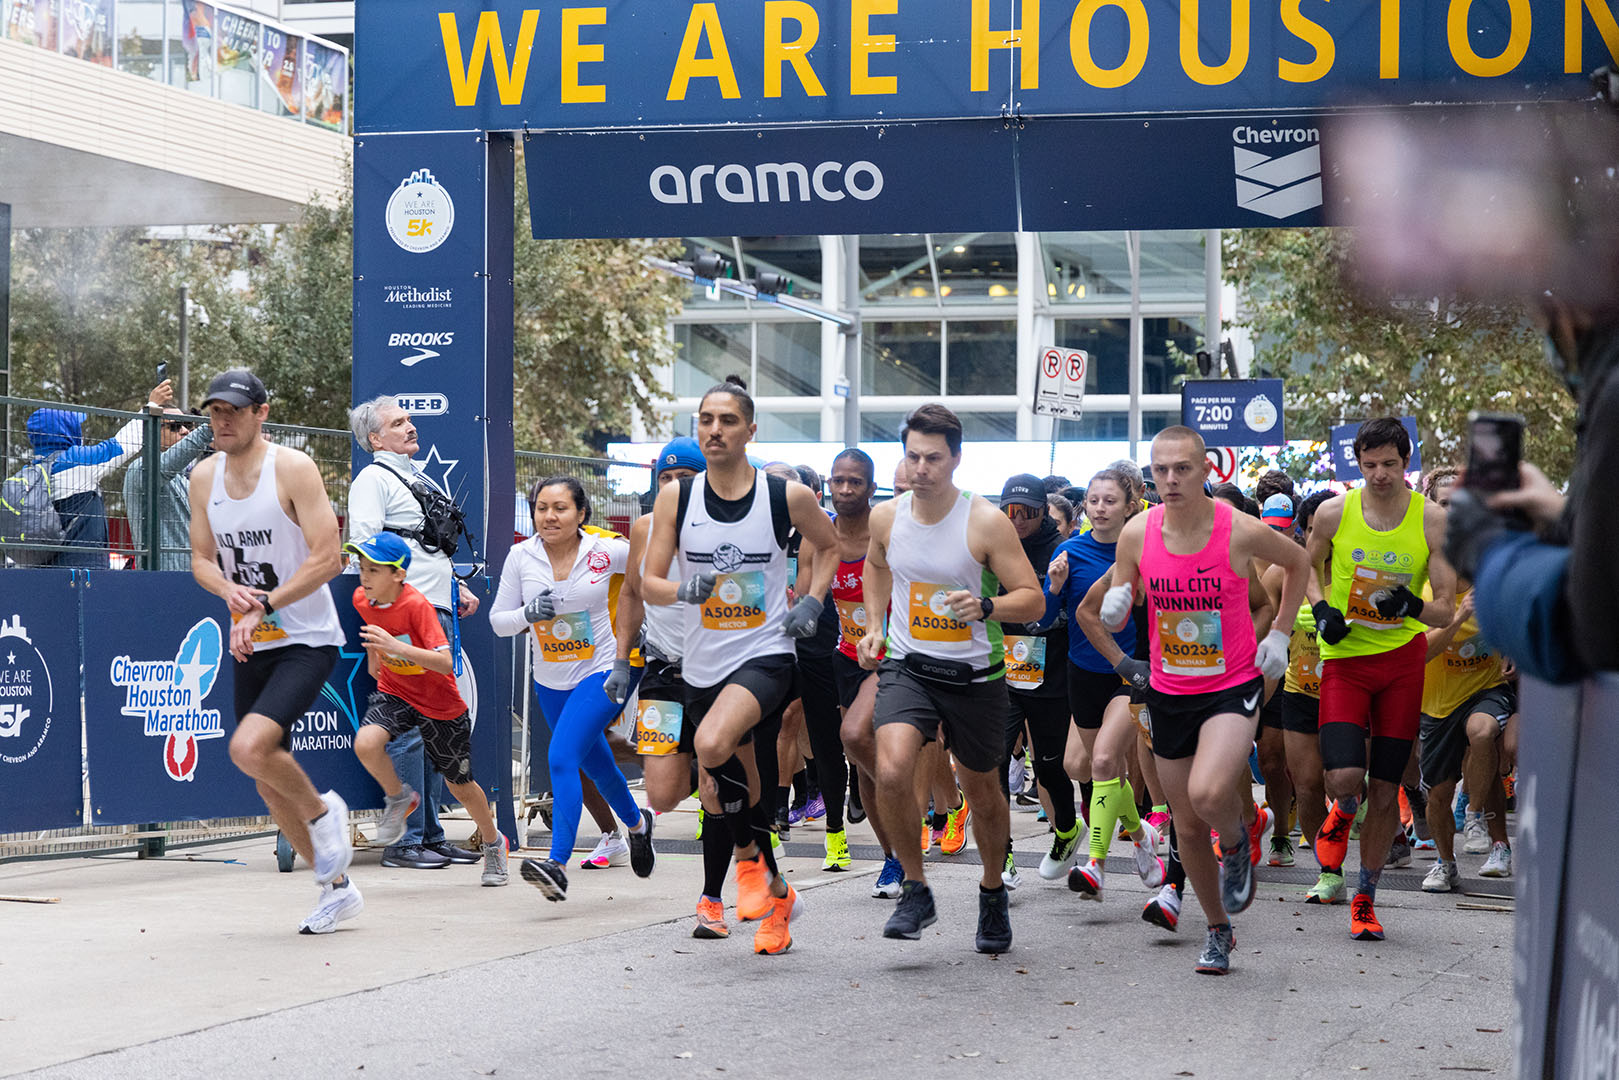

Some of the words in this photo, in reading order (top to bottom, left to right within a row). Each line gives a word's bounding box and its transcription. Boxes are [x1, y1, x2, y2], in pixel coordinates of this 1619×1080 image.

[268, 30, 281, 49] TO
[438, 7, 607, 107] WE
[665, 0, 899, 101] ARE
[969, 0, 1619, 93] HOUSTON
[1232, 125, 1321, 144] Chevron
[649, 160, 885, 204] aramco
[404, 201, 418, 209] WE
[421, 200, 435, 208] ARE
[404, 208, 436, 216] HOUSTON
[384, 287, 453, 303] Methodist
[388, 332, 454, 346] BROOKS
[1194, 405, 1233, 422] 7:00
[238, 529, 272, 547] ARMY
[1150, 577, 1184, 593] MILL
[1188, 577, 1221, 593] CITY
[1152, 594, 1224, 610] RUNNING
[704, 603, 761, 619] A50286
[719, 620, 748, 628] HECTOR
[544, 638, 590, 653] A50038
[1164, 643, 1219, 656] A50232
[921, 664, 957, 676] aramco
[1005, 662, 1041, 672] 50259
[1175, 658, 1206, 666] NATHAN
[13, 669, 32, 684] ARE
[113, 659, 174, 682] Chevron
[0, 685, 32, 697] OUSTON
[129, 685, 191, 707] Houston
[147, 709, 218, 733] Marathon
[290, 710, 338, 732] STON
[2, 754, 27, 764] CHEVRON
[27, 746, 38, 759] AND
[37, 717, 52, 749] ARAMCO
[292, 734, 351, 751] MARATHON
[636, 730, 675, 744] 50200
